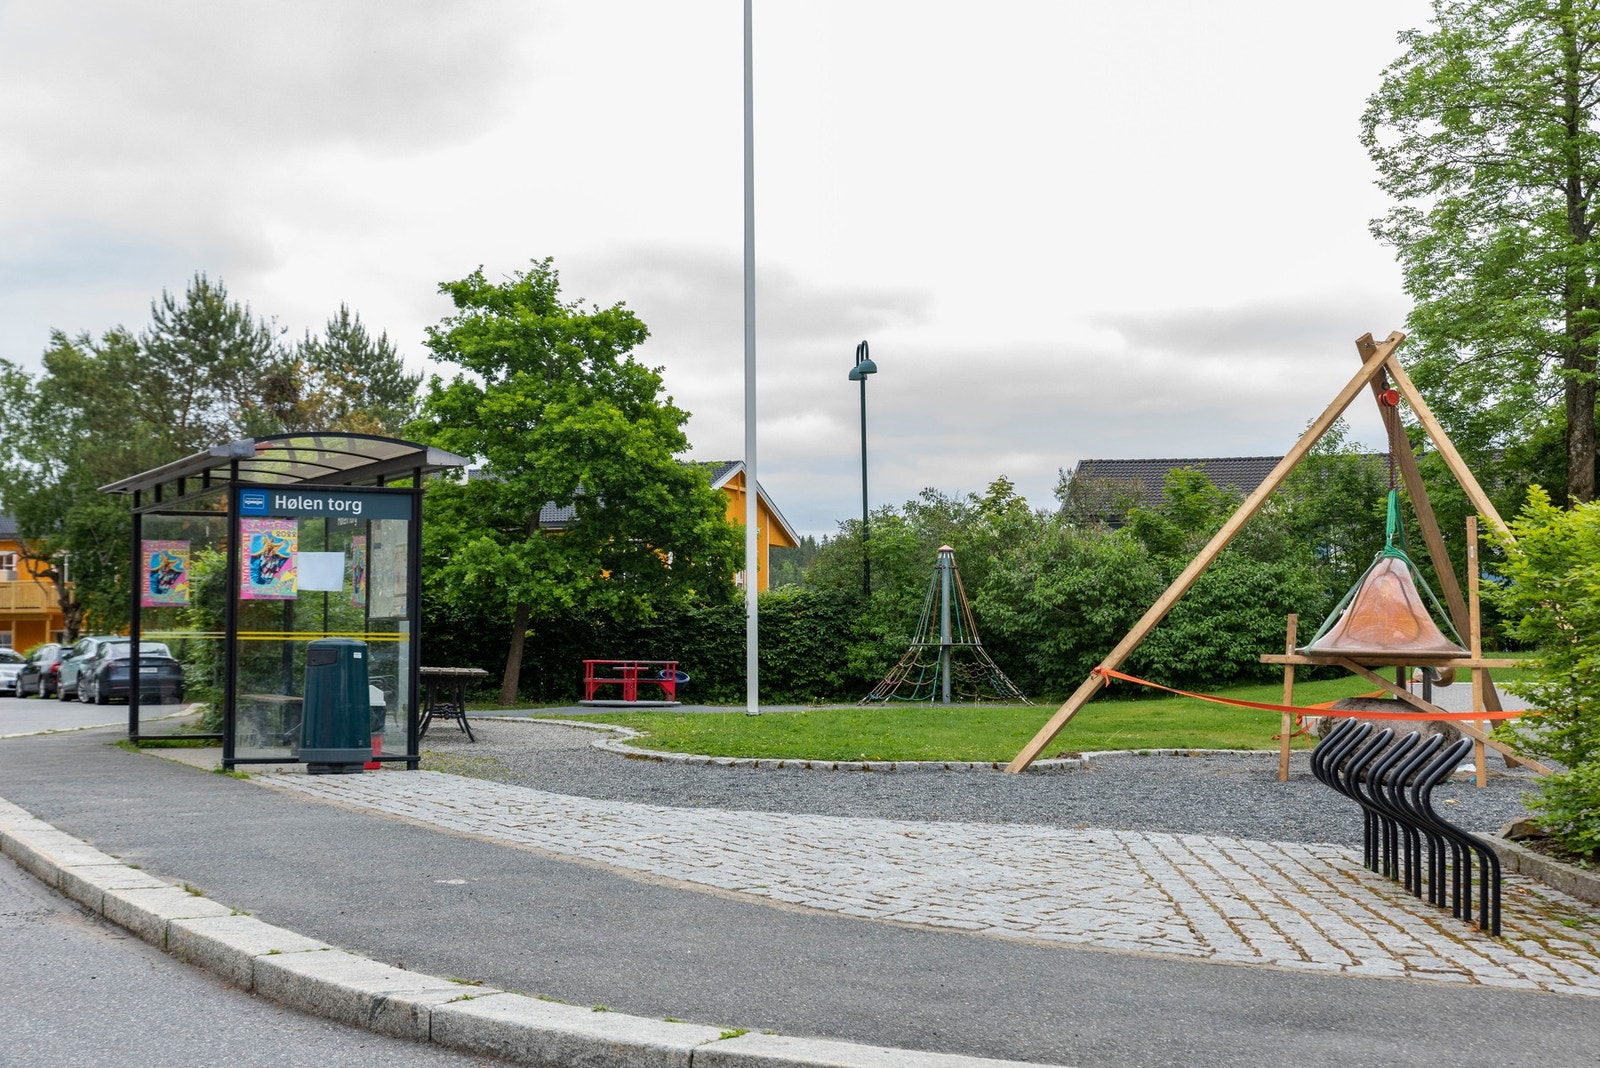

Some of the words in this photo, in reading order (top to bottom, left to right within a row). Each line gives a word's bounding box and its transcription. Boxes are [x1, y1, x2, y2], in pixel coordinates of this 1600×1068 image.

[275, 495, 323, 510] Hølen
[328, 498, 362, 514] torg
[276, 530, 297, 538] 2022
